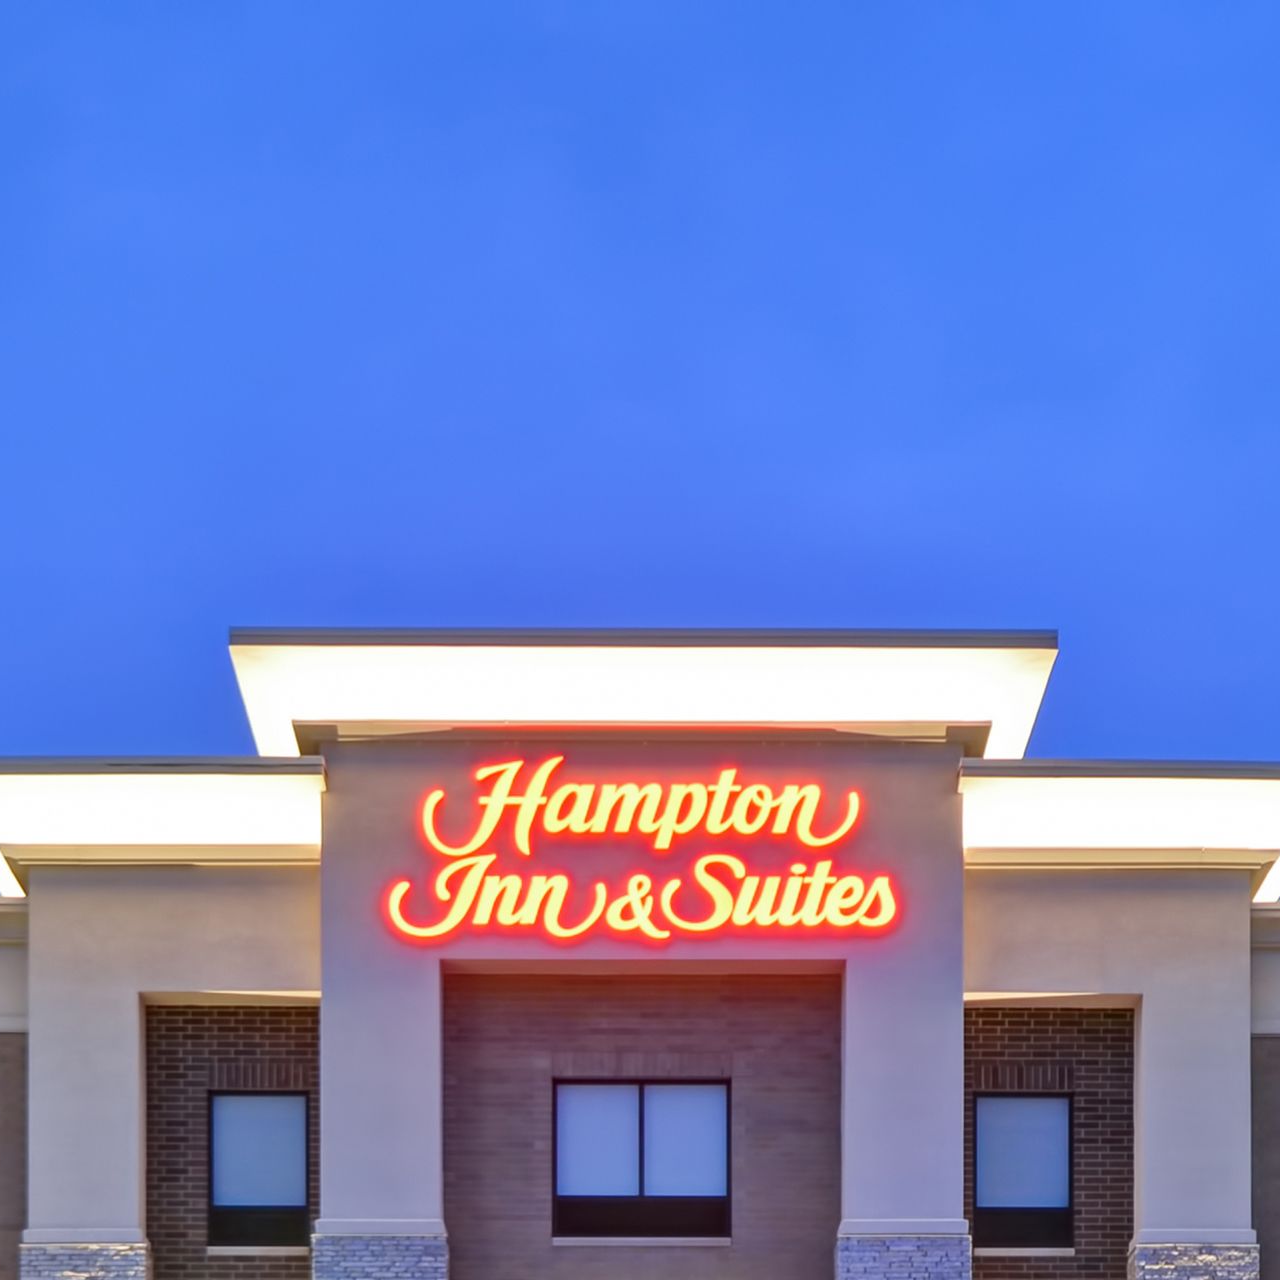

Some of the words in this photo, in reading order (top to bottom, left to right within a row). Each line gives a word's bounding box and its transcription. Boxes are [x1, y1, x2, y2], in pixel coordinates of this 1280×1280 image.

[422, 755, 860, 856] Hampton
[388, 854, 607, 937] Inn
[605, 873, 671, 939] &
[661, 854, 897, 932] Suites
